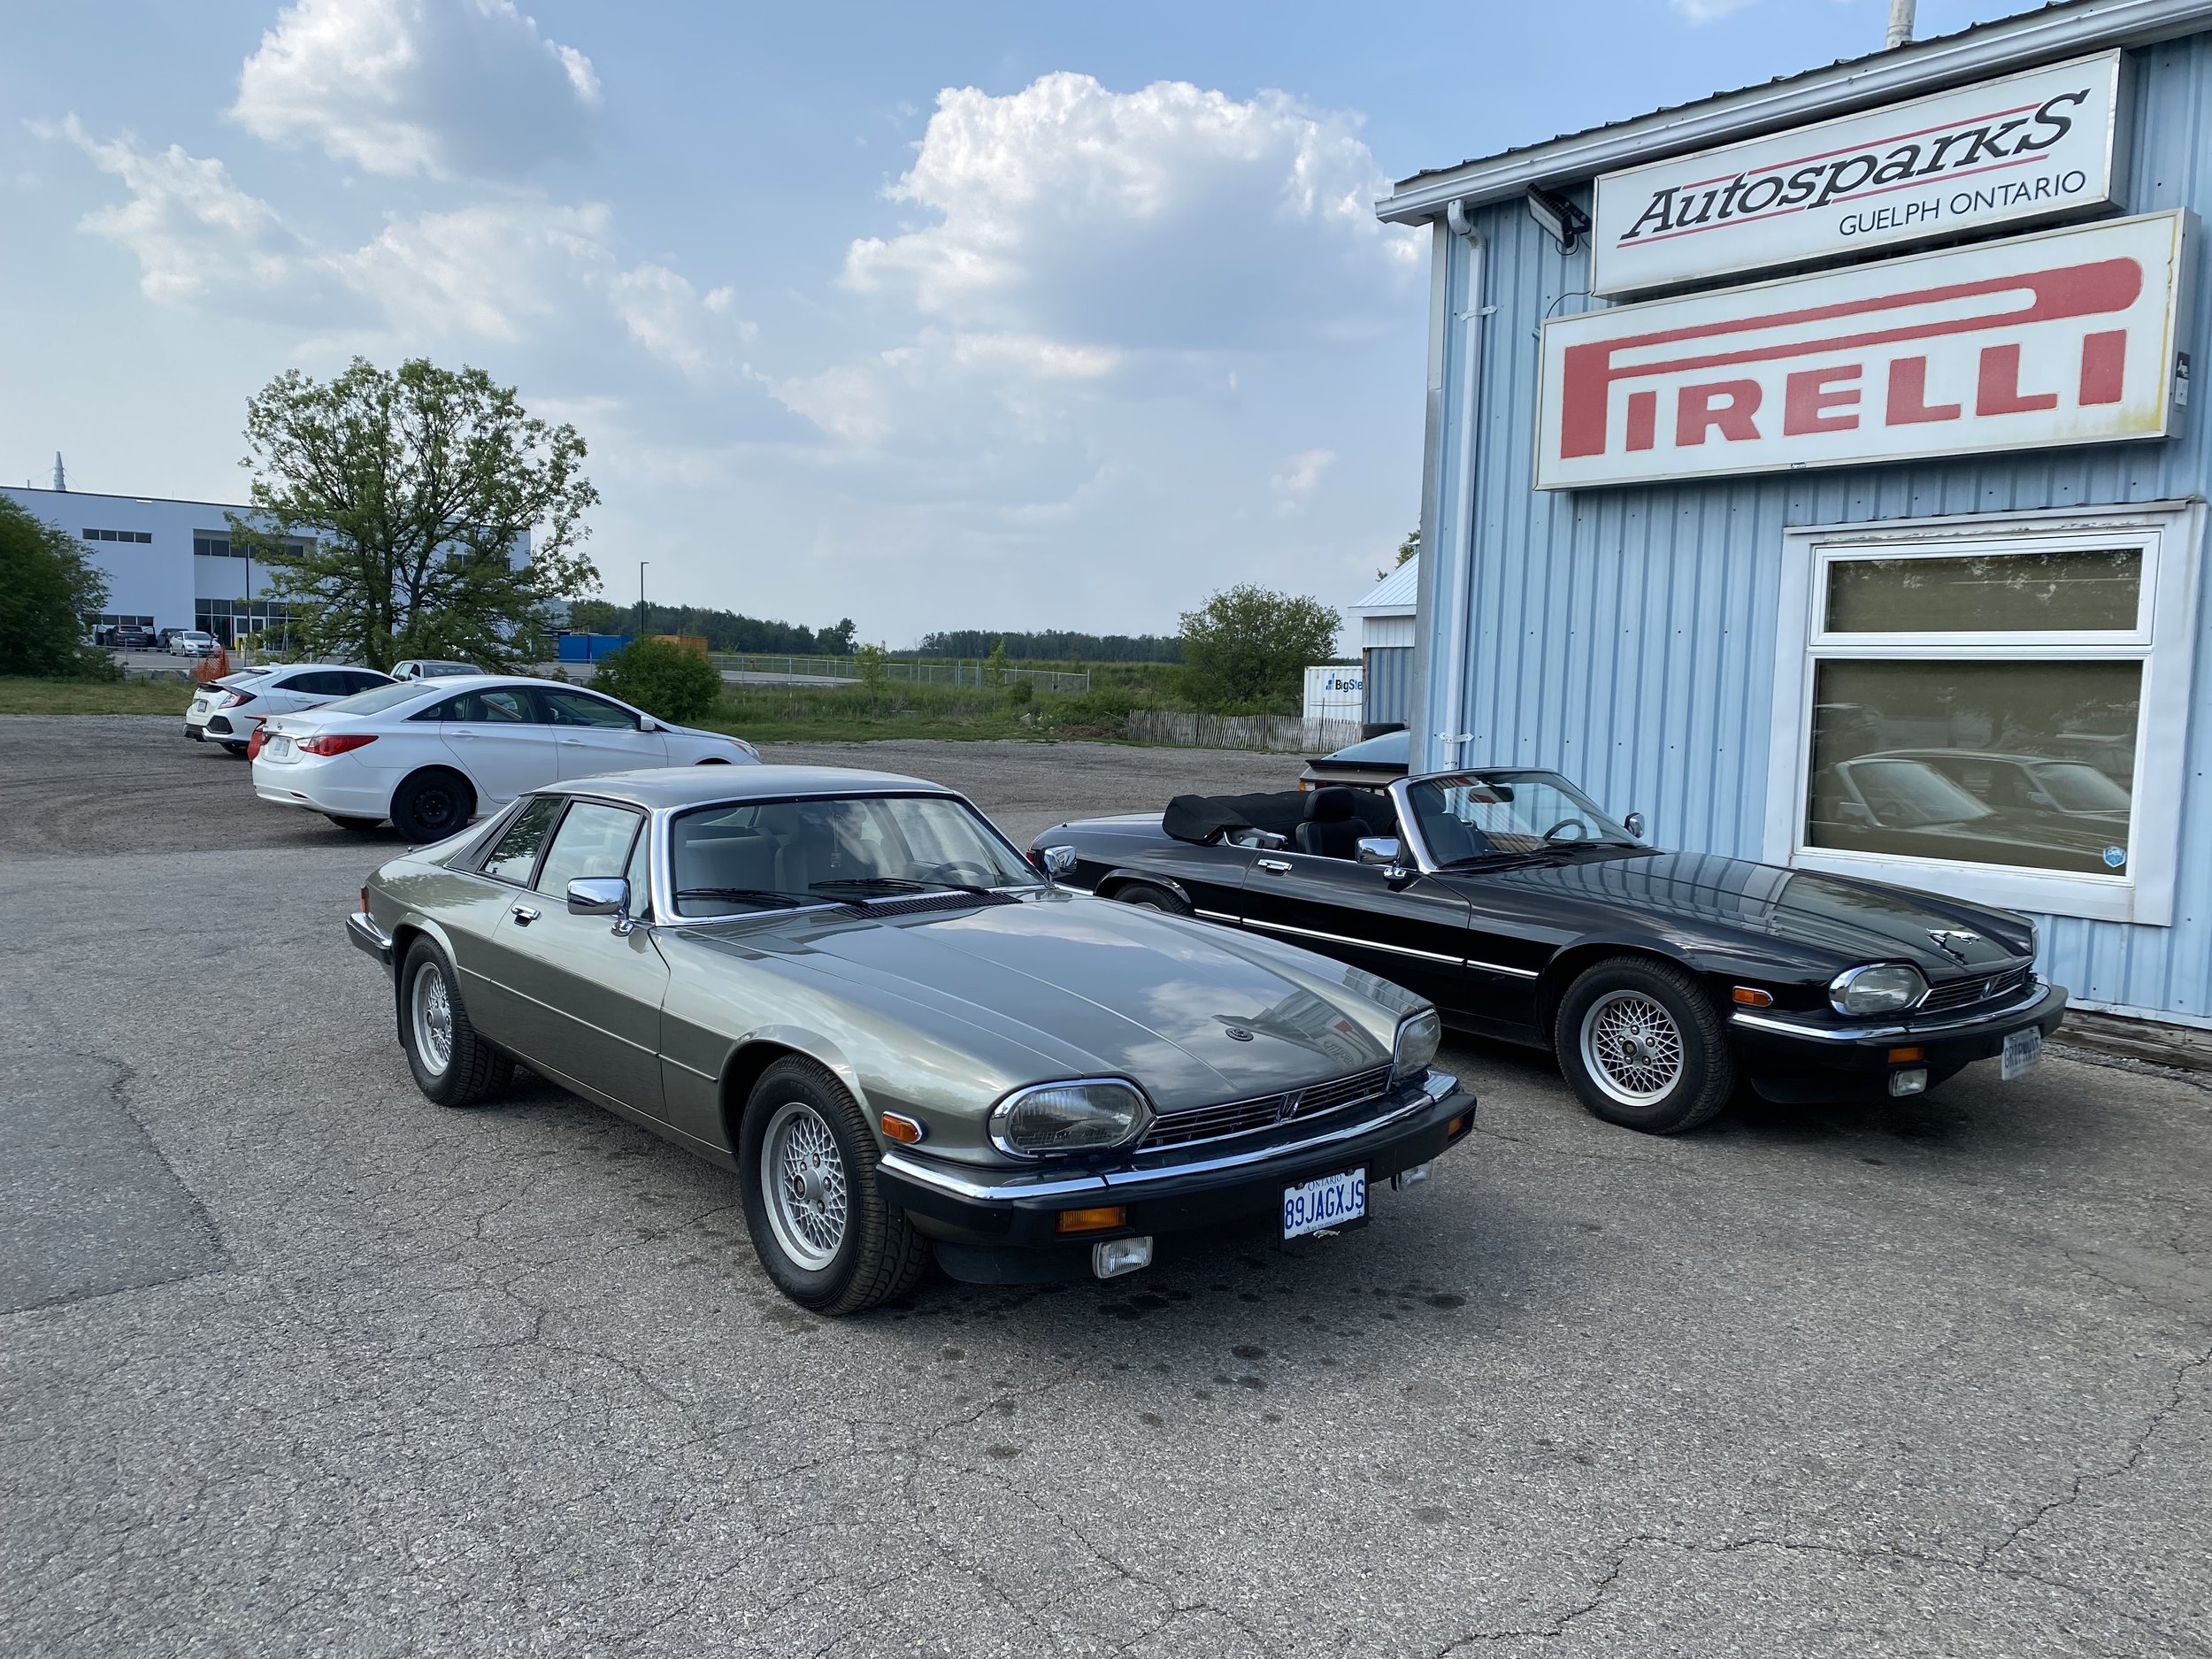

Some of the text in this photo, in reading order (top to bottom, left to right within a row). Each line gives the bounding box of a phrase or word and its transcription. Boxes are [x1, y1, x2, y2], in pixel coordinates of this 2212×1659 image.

[1839, 171, 2086, 236] GUELPH ONTARIO
[1560, 257, 2144, 459] PIRELLI
[1285, 1179, 1364, 1230] 89JAGXJS
[1308, 1174, 1342, 1191] ONTARIO
